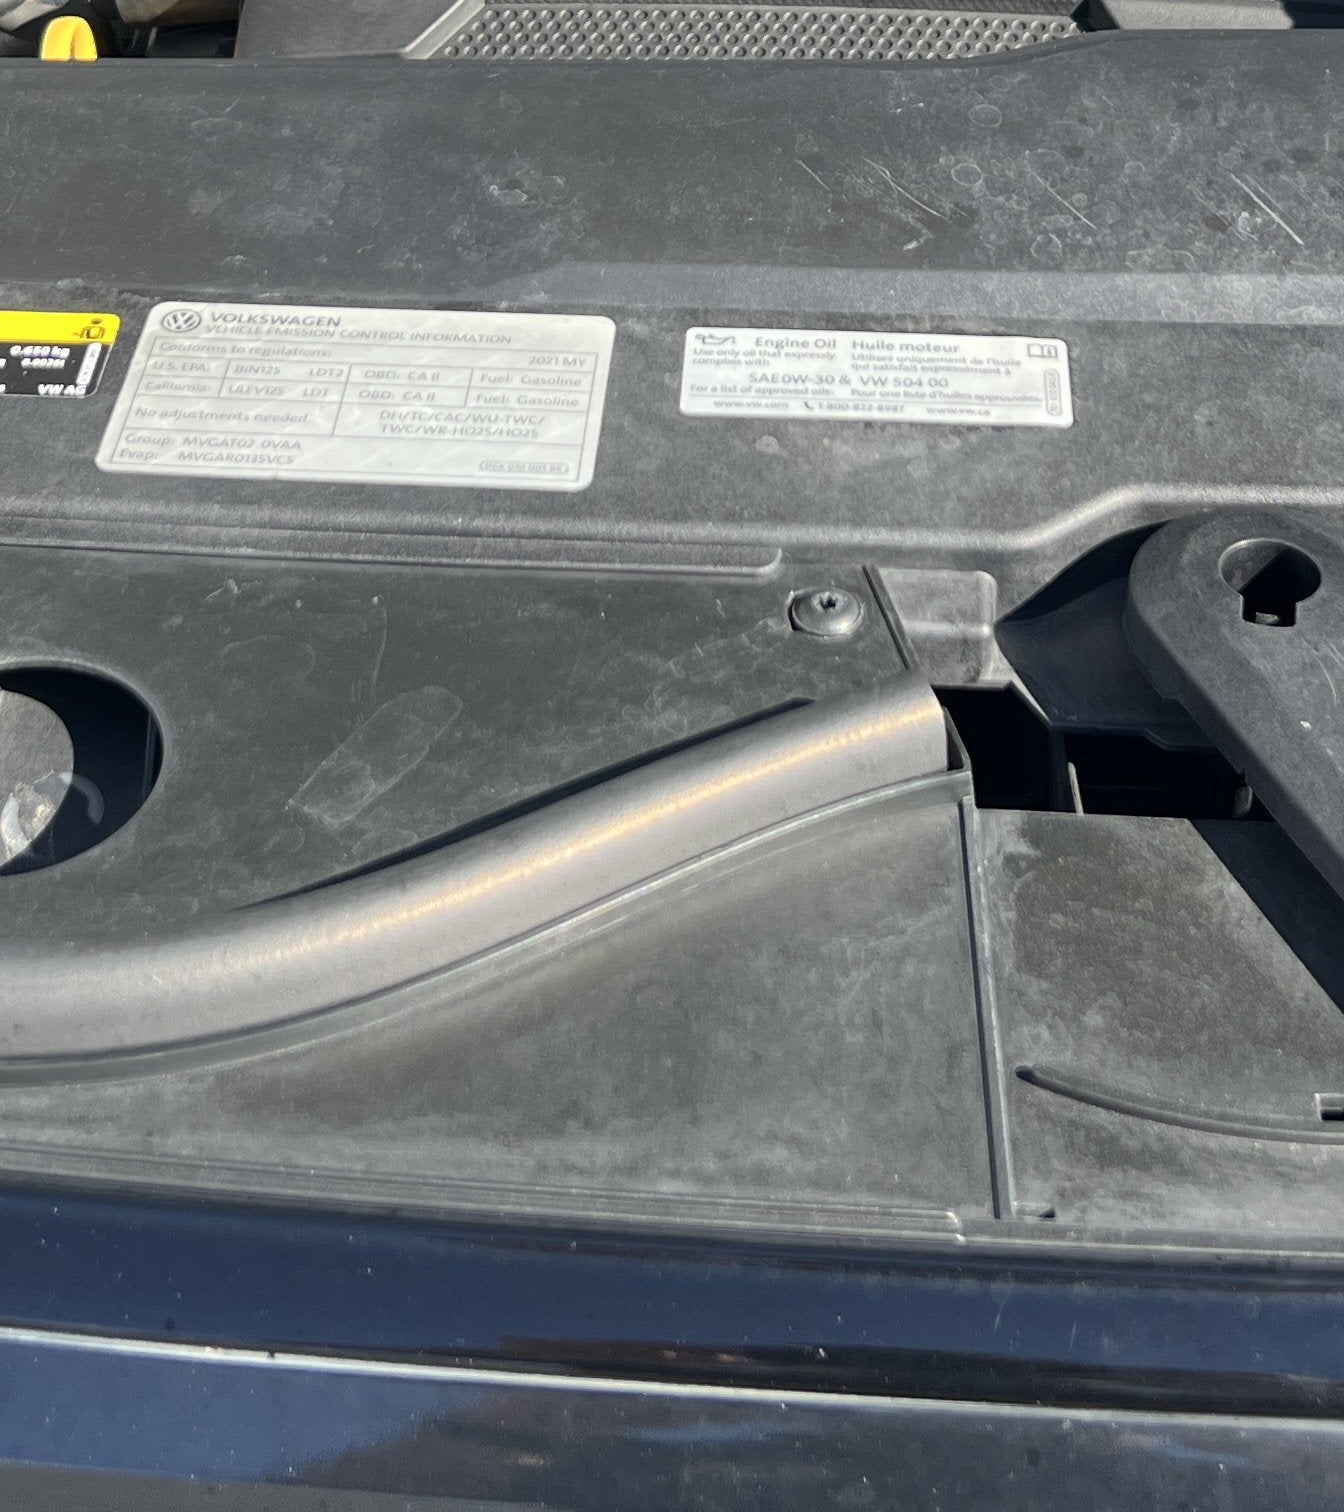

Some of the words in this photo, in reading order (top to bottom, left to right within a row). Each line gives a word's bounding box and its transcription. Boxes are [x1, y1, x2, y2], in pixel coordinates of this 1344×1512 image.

[210, 312, 342, 328] VOLKSWAGEN
[206, 324, 262, 336] VEHICLE
[266, 326, 336, 338] EMISSION
[339, 328, 405, 341] CONTROL
[410, 331, 512, 345] INFORMATION
[755, 336, 810, 352] Engine
[814, 337, 838, 348] Oil
[851, 339, 895, 351] Huile
[900, 343, 960, 354] moteur
[528, 355, 560, 366] 2021
[562, 357, 586, 368] MY
[408, 371, 429, 381] CA
[520, 375, 583, 387] Gasoline
[860, 376, 889, 387] VW
[892, 376, 923, 388] 504
[927, 377, 949, 388] 00
[302, 387, 330, 397] LDT
[402, 391, 424, 401] CA
[516, 394, 580, 407] Gasoline
[135, 407, 156, 417] No
[159, 407, 250, 422] adjustments
